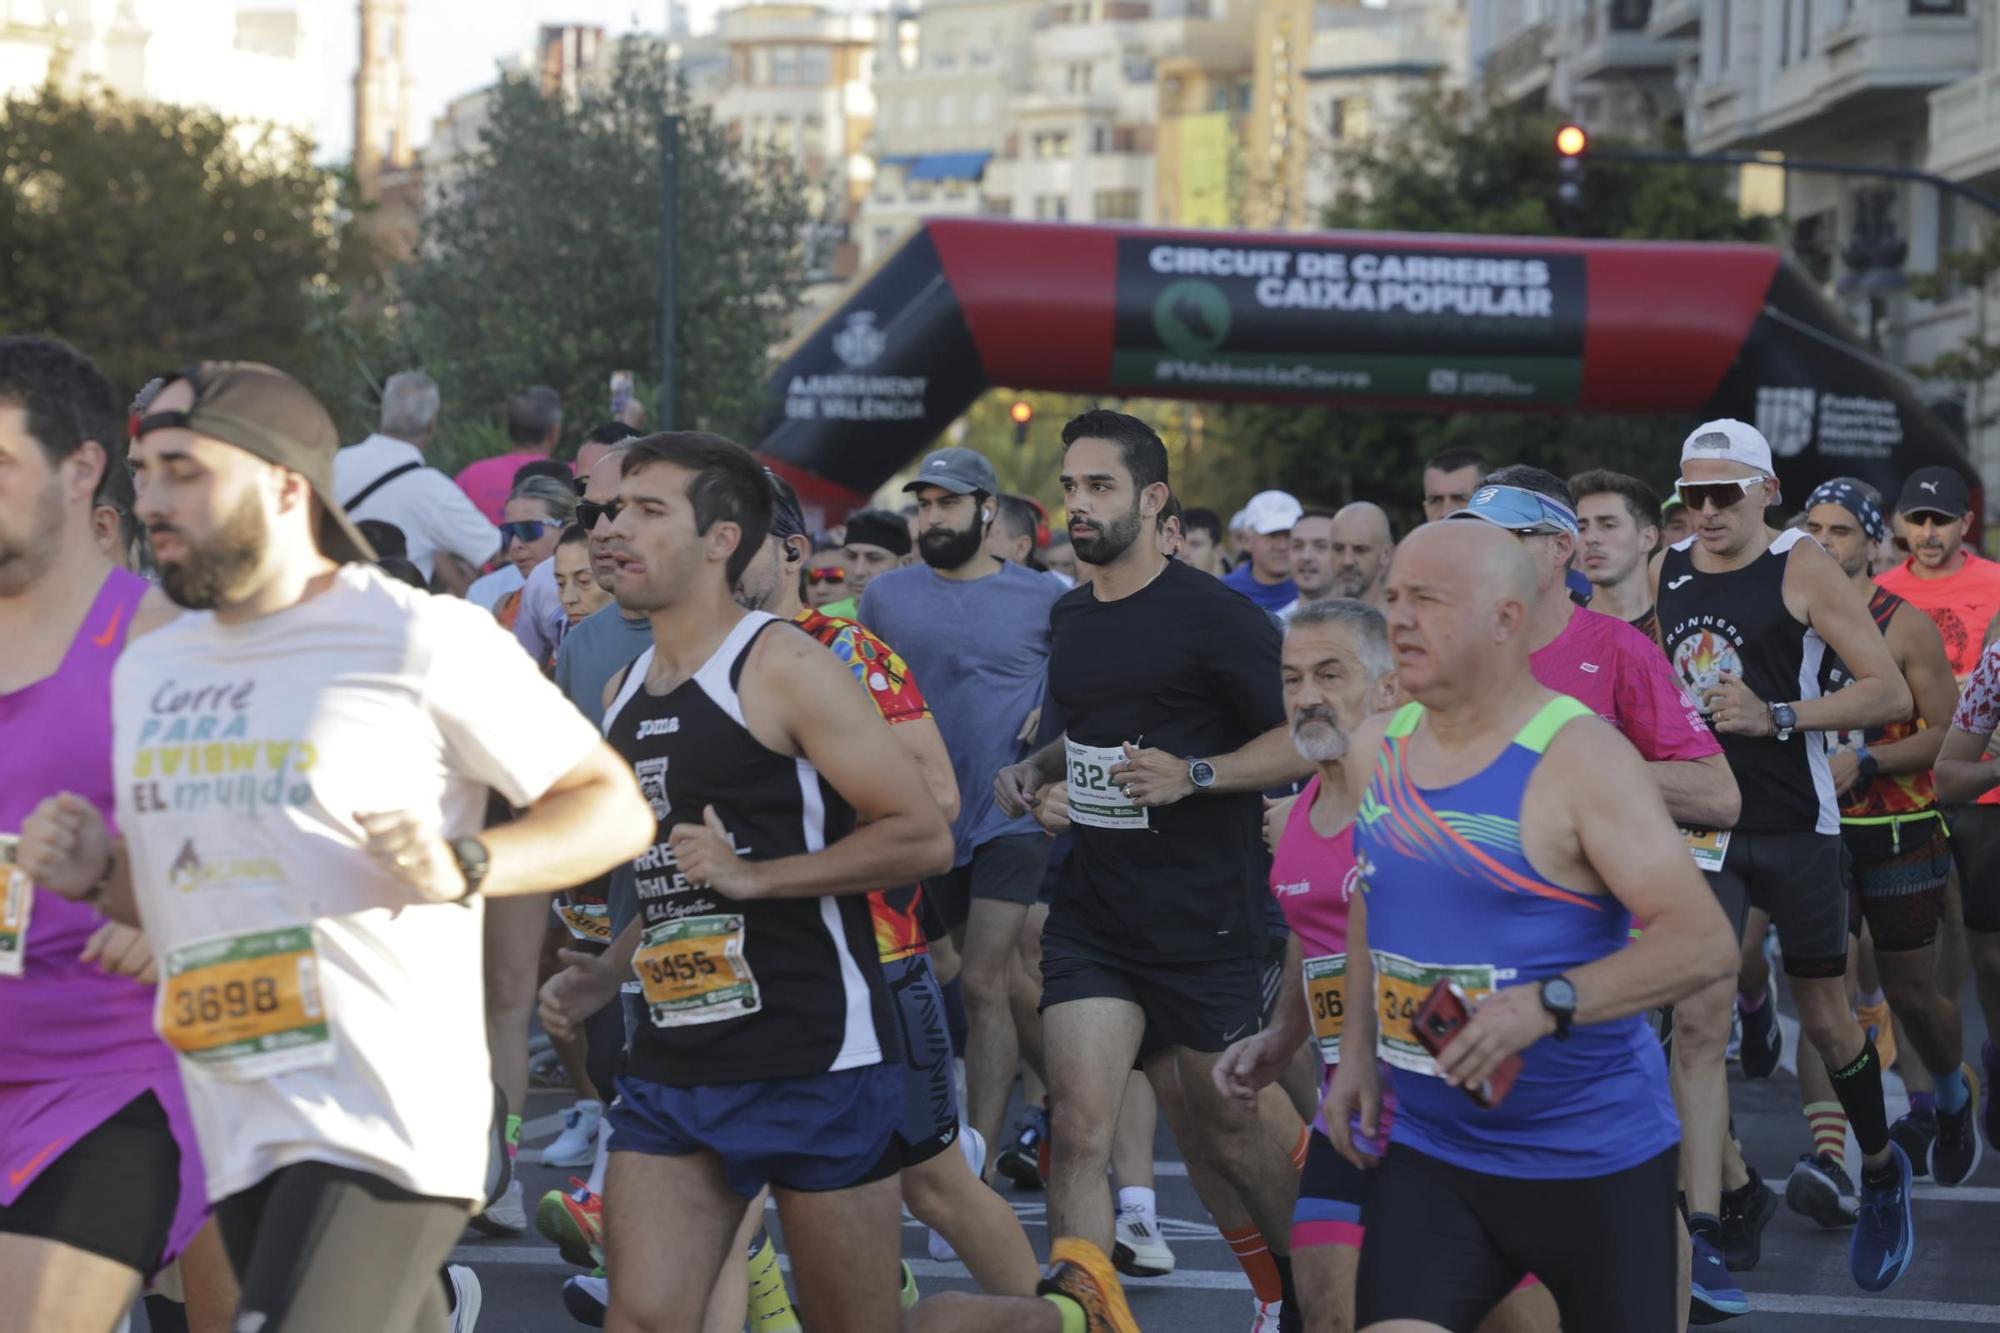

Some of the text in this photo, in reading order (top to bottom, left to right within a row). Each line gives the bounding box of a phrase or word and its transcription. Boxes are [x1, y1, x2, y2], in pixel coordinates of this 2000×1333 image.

[1148, 246, 1551, 287] CIRCUIT DE CARRERES
[785, 396, 816, 420] DE
[1667, 615, 1744, 647] RUNNERS
[150, 679, 256, 714] Corre
[138, 714, 248, 745] PARA
[132, 757, 313, 821] EL mundo
[644, 952, 717, 984] 3455
[175, 976, 279, 1027] 3698
